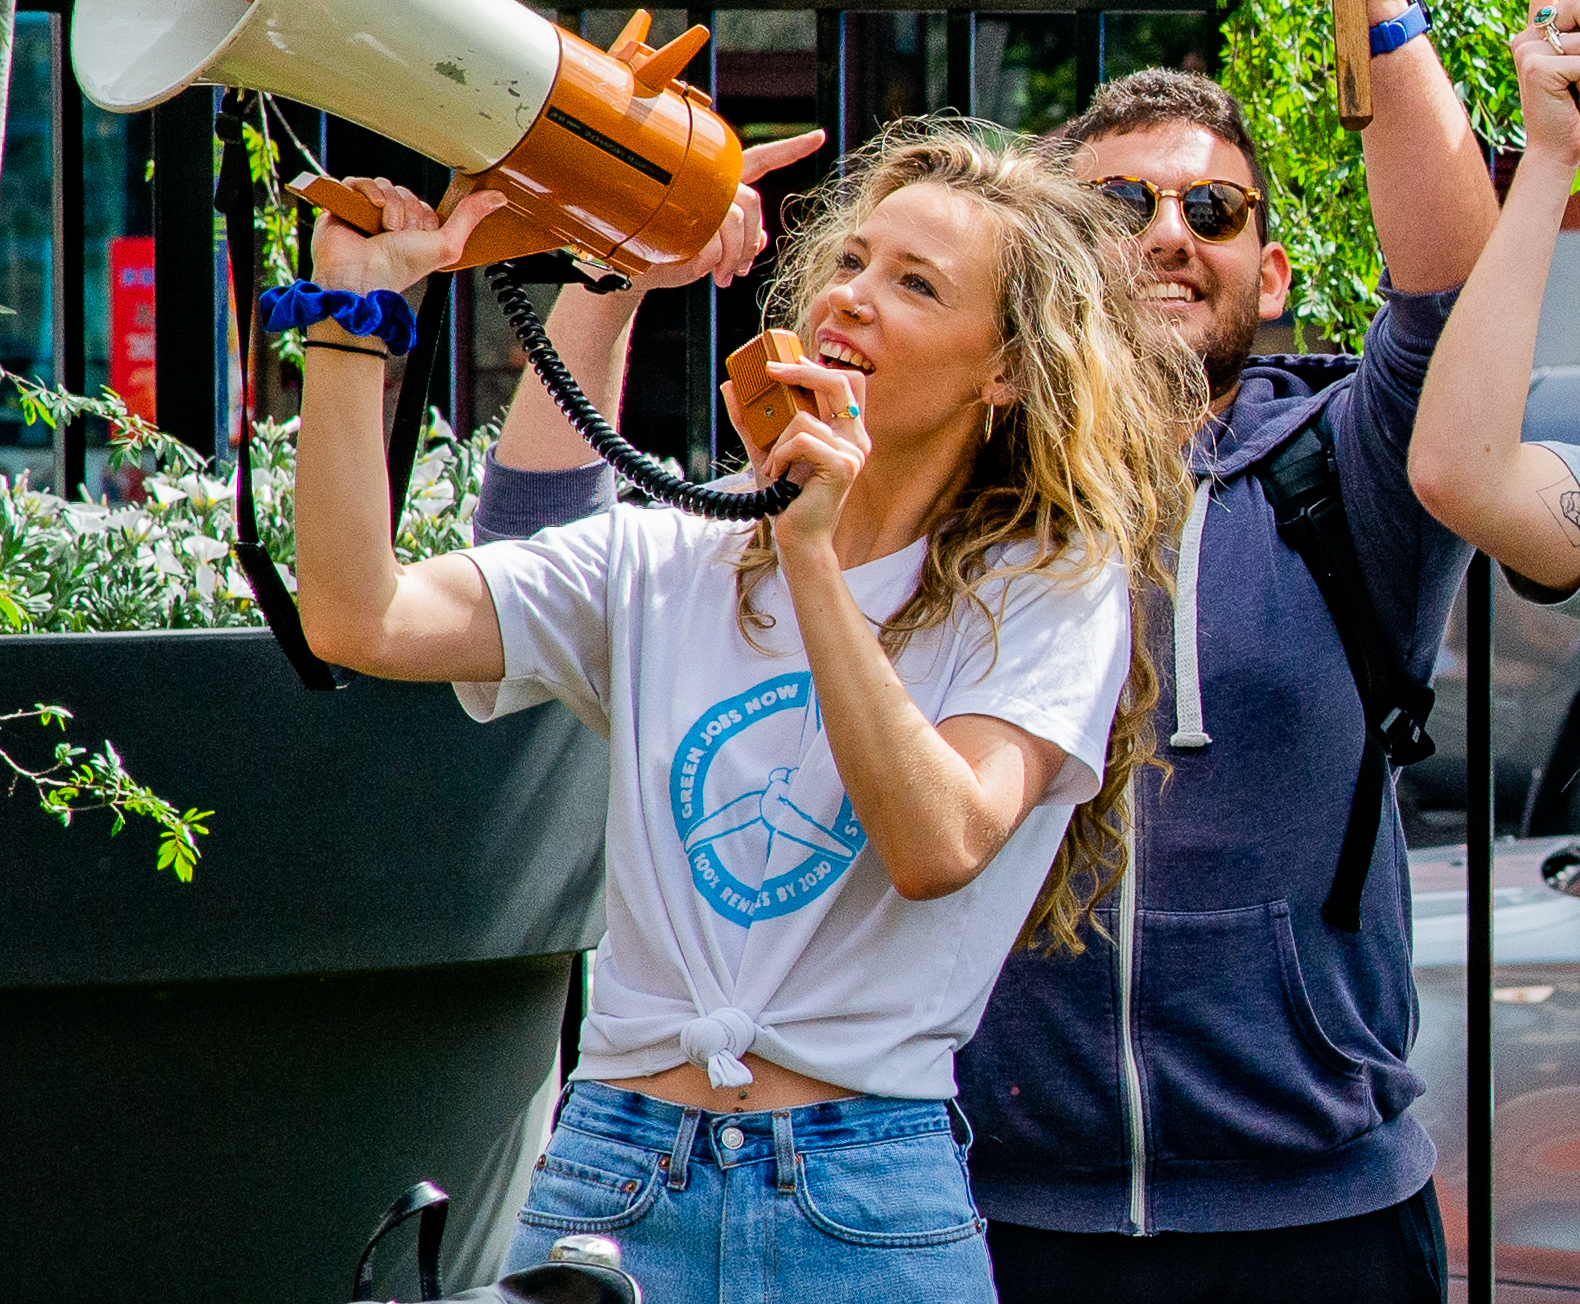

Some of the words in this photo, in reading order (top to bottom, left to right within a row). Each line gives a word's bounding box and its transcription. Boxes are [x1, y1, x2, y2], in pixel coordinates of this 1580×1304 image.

[681, 747, 707, 819] GREEN
[699, 709, 743, 747] JOBS
[744, 683, 800, 715] NOW
[693, 852, 721, 889] 100%
[777, 886, 796, 903] BY
[798, 860, 833, 891] 2030
